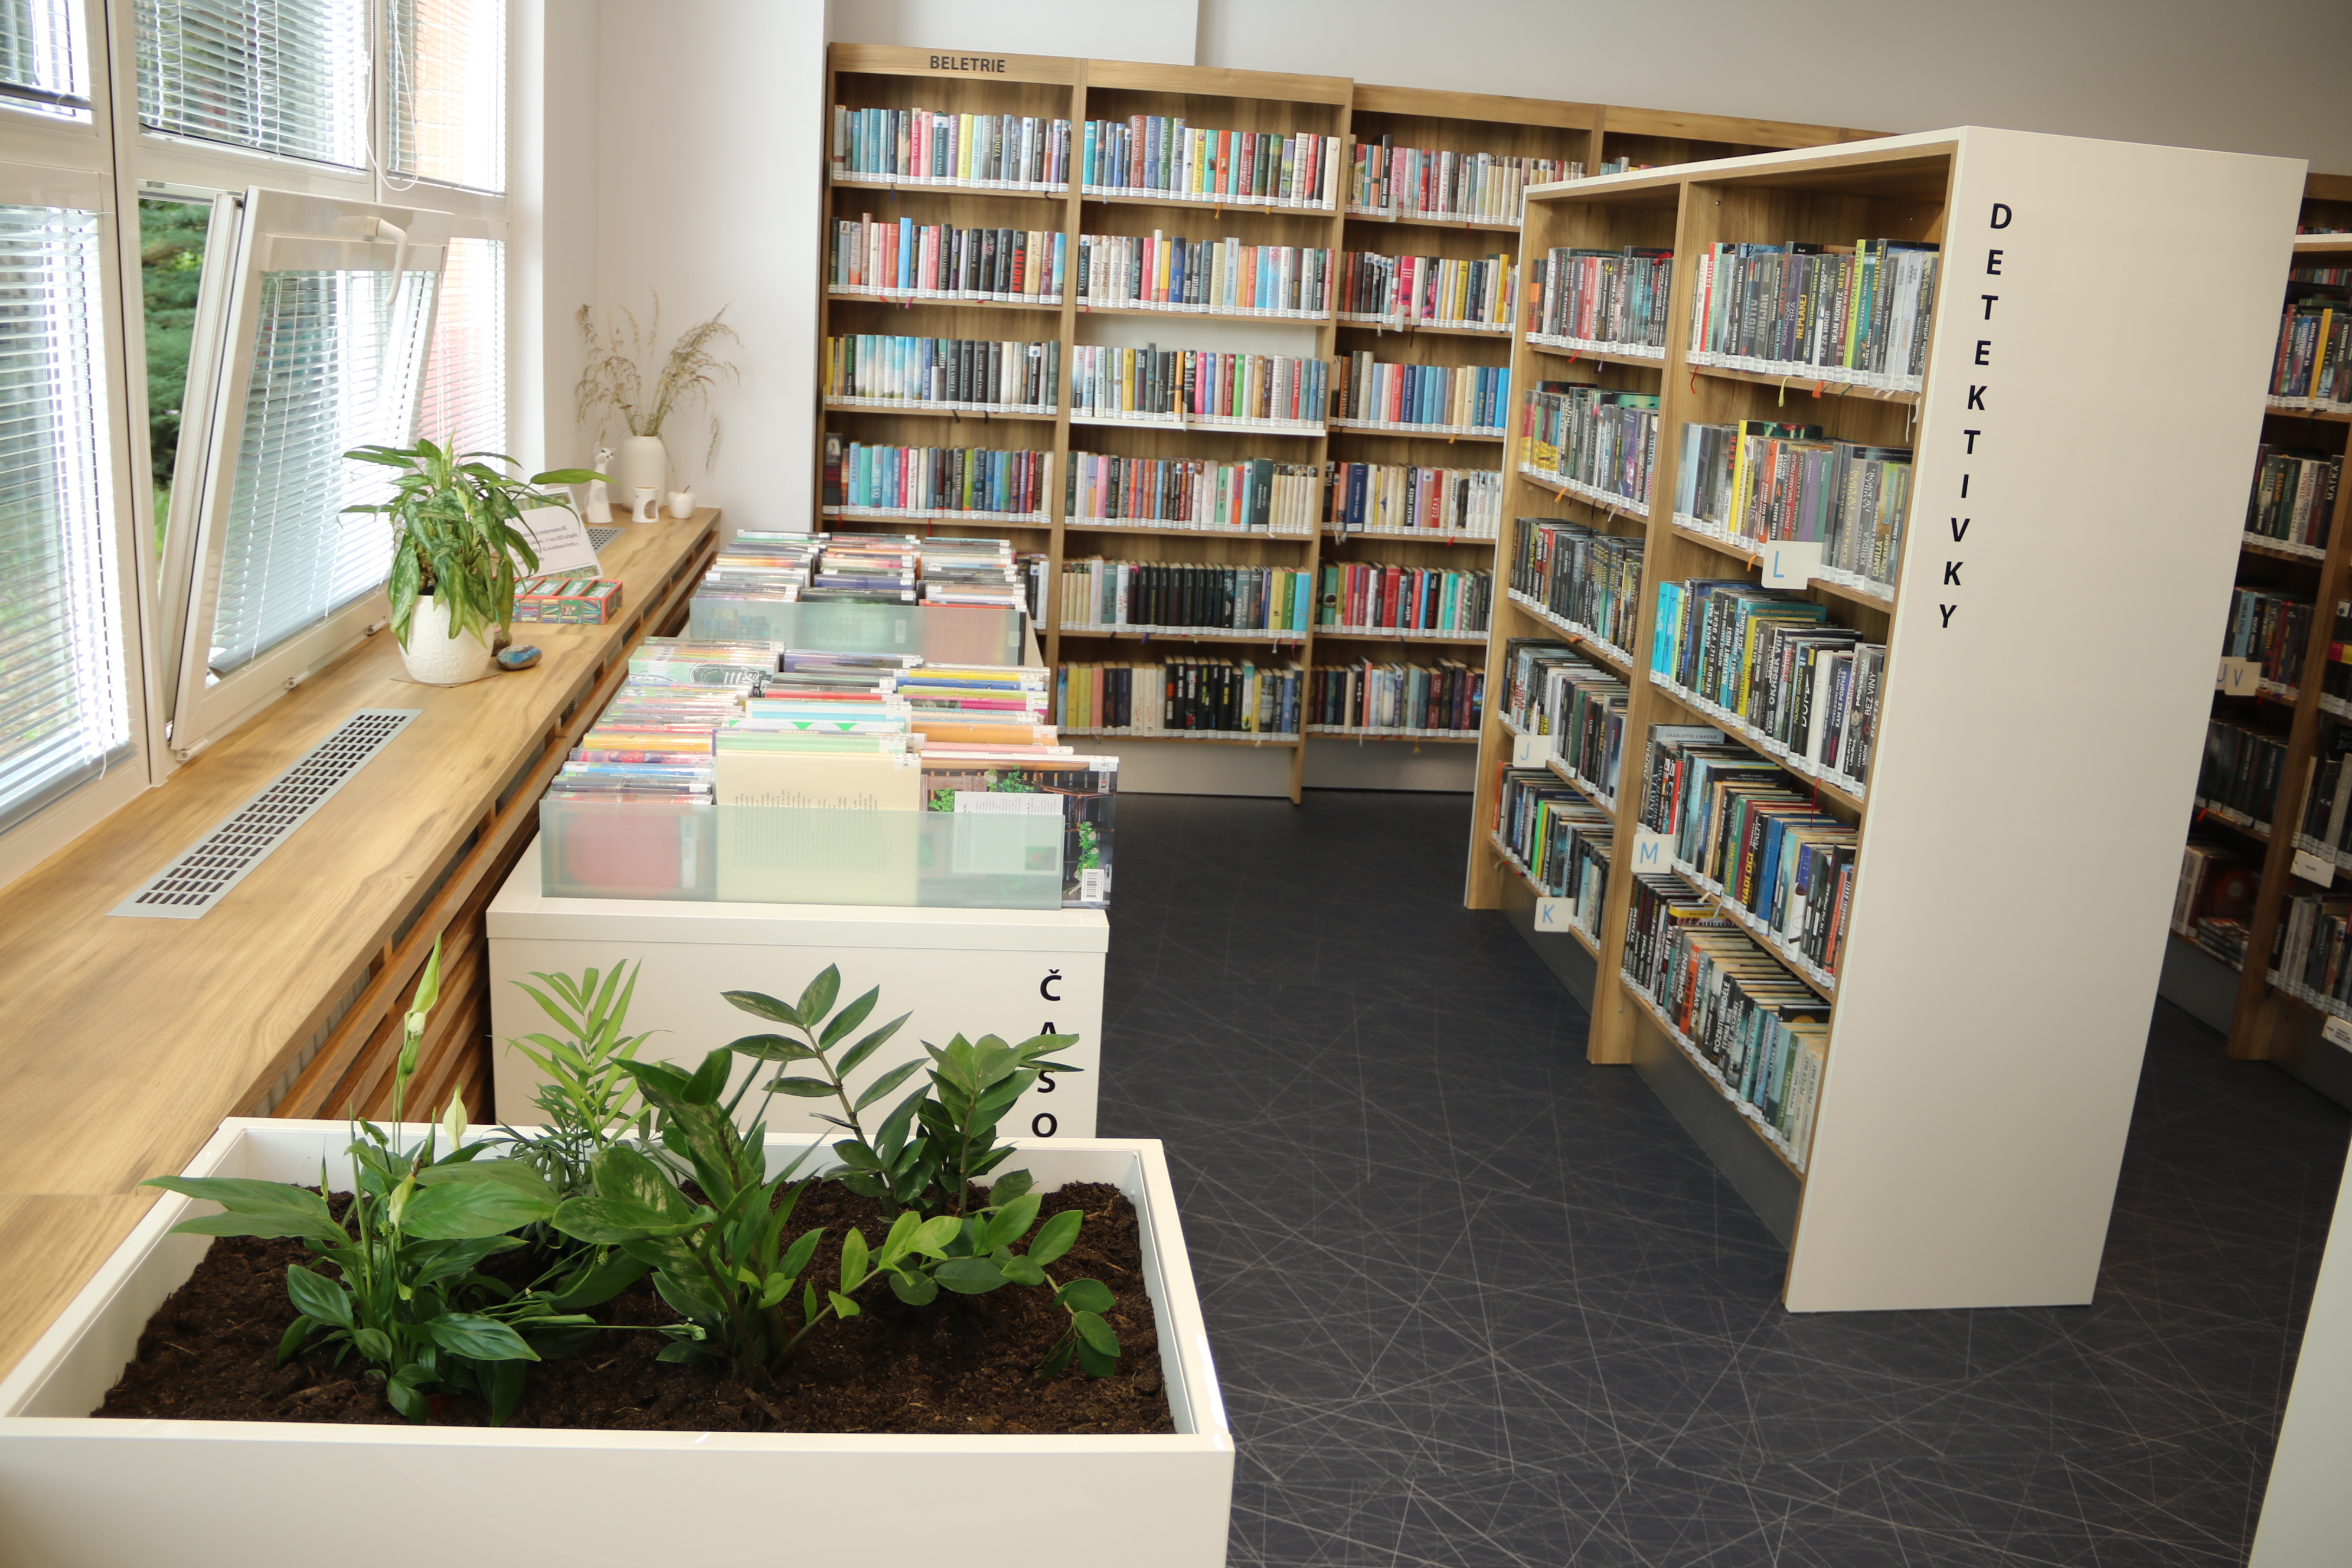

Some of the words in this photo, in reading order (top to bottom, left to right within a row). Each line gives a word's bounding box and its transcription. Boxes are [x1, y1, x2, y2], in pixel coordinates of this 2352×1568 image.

[930, 55, 1005, 73] BELETRIE
[1011, 249, 1025, 292] KMOTRY
[1834, 292, 1843, 321] KOONTZ
[1831, 322, 1840, 343] DEAN
[1939, 203, 2012, 628] DETEKTIVKY
[1728, 436, 1737, 469] KERR
[2298, 472, 2308, 499] STRACH
[2327, 465, 2340, 500] MATKA
[1773, 550, 1785, 577] L
[1872, 541, 1883, 577] CAMILLA
[1769, 656, 1781, 705] OKRSEK
[1775, 635, 1783, 653] VIII
[1867, 671, 1876, 694] VINY
[2234, 668, 2243, 687] V
[1864, 697, 1873, 716] BEZ
[1520, 742, 1530, 760] J
[1639, 841, 1658, 864] M
[1542, 904, 1555, 924] K
[1713, 1017, 1724, 1053] ROZBITÍ
